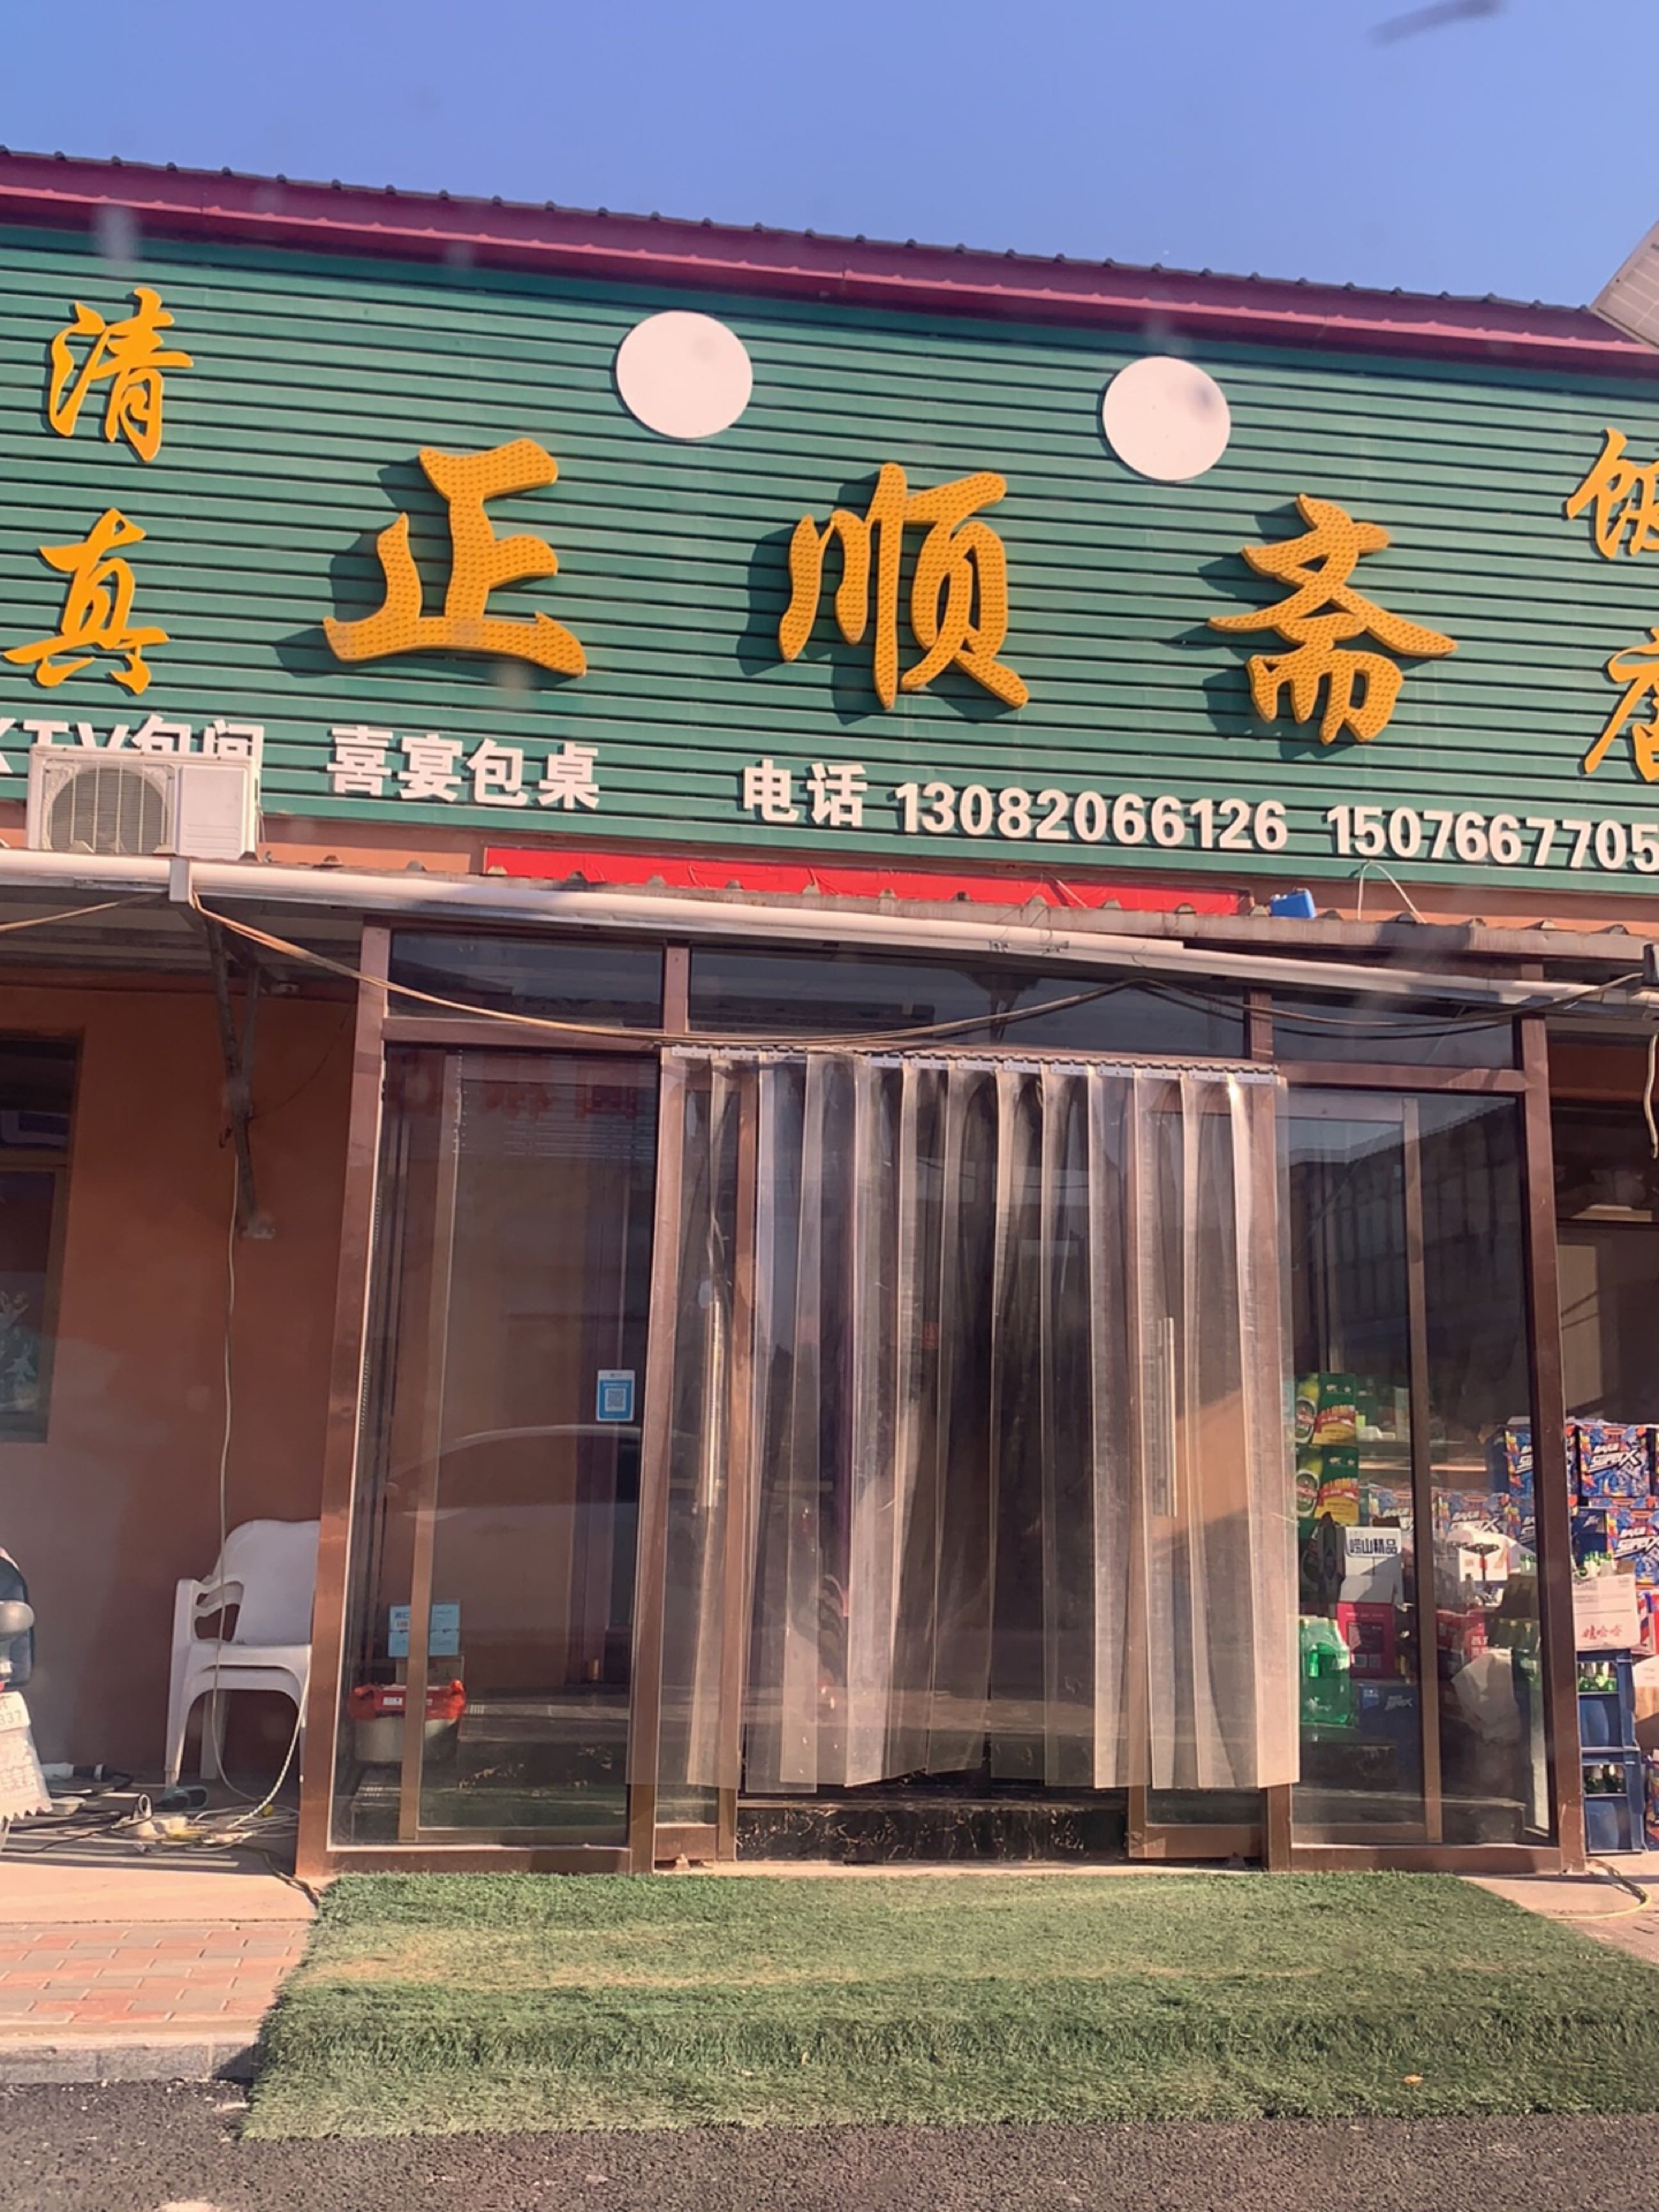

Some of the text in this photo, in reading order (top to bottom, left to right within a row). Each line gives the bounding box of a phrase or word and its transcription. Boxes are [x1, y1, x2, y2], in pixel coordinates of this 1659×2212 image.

[4, 287, 194, 695] 清真
[323, 438, 1458, 744] 正顺斋
[327, 725, 600, 810] 喜宴包桌
[744, 758, 1659, 872] 电话 13082066126 1507667705
